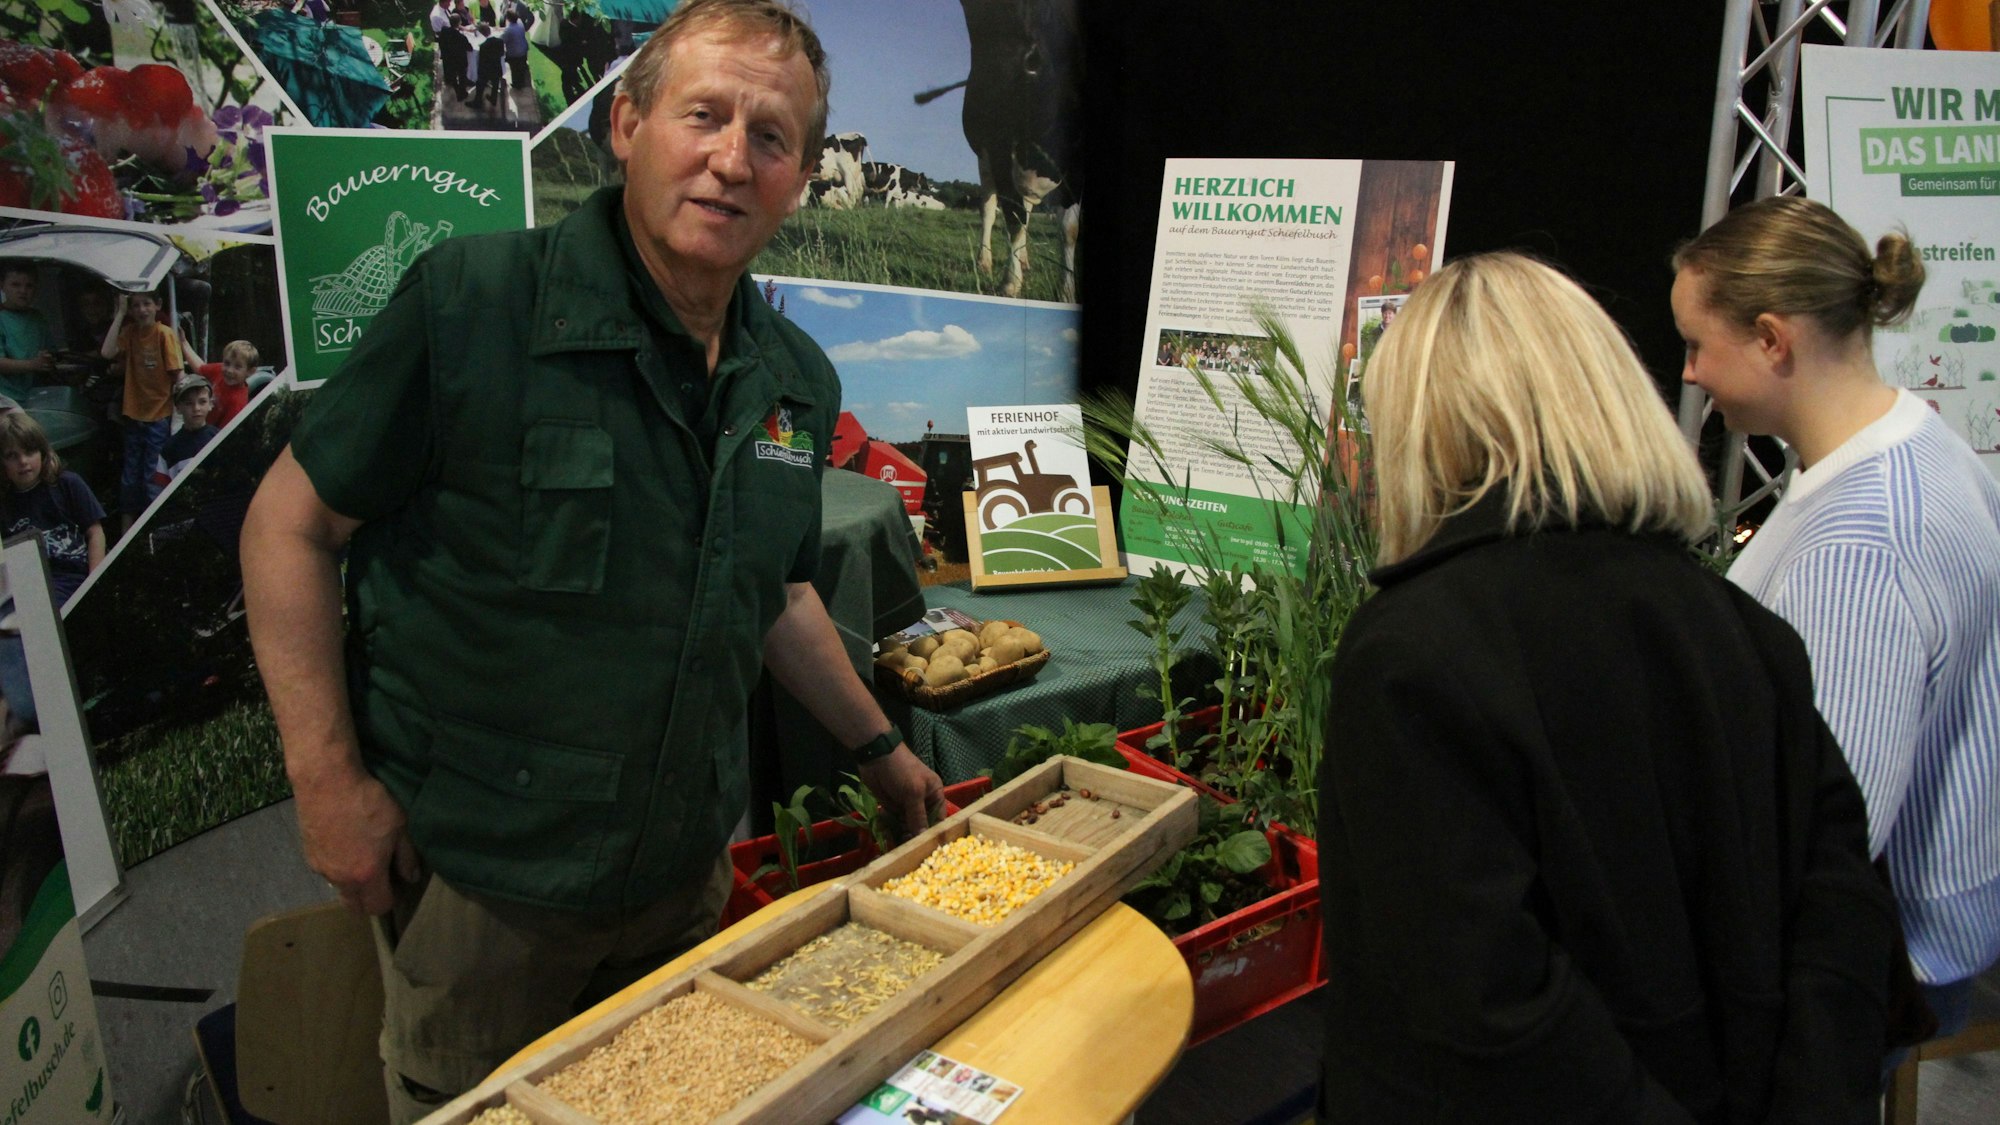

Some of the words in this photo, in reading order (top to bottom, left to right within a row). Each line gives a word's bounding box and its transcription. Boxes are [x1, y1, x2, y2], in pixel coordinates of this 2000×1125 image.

[1891, 86, 1964, 121] WIR
[1865, 135, 1926, 167] DAS
[1934, 134, 2000, 165] LAN
[306, 163, 501, 223] Bauerngut
[1174, 177, 1295, 198] HERZLICH
[1908, 177, 1977, 191] Gemeinsam
[1980, 177, 1996, 190] für
[1172, 201, 1343, 225] WILLKOMMEN
[1169, 225, 1186, 235] auf
[1188, 225, 1210, 235] dem
[1211, 226, 1267, 239] Bauerngut
[1268, 228, 1338, 240] Schiefelbusch
[318, 319, 362, 347] Sch
[991, 411, 1059, 424] FERIENHOF
[977, 428, 990, 436] mit
[992, 427, 1018, 435] aktiver
[1019, 425, 1076, 435] Landwirtschaft
